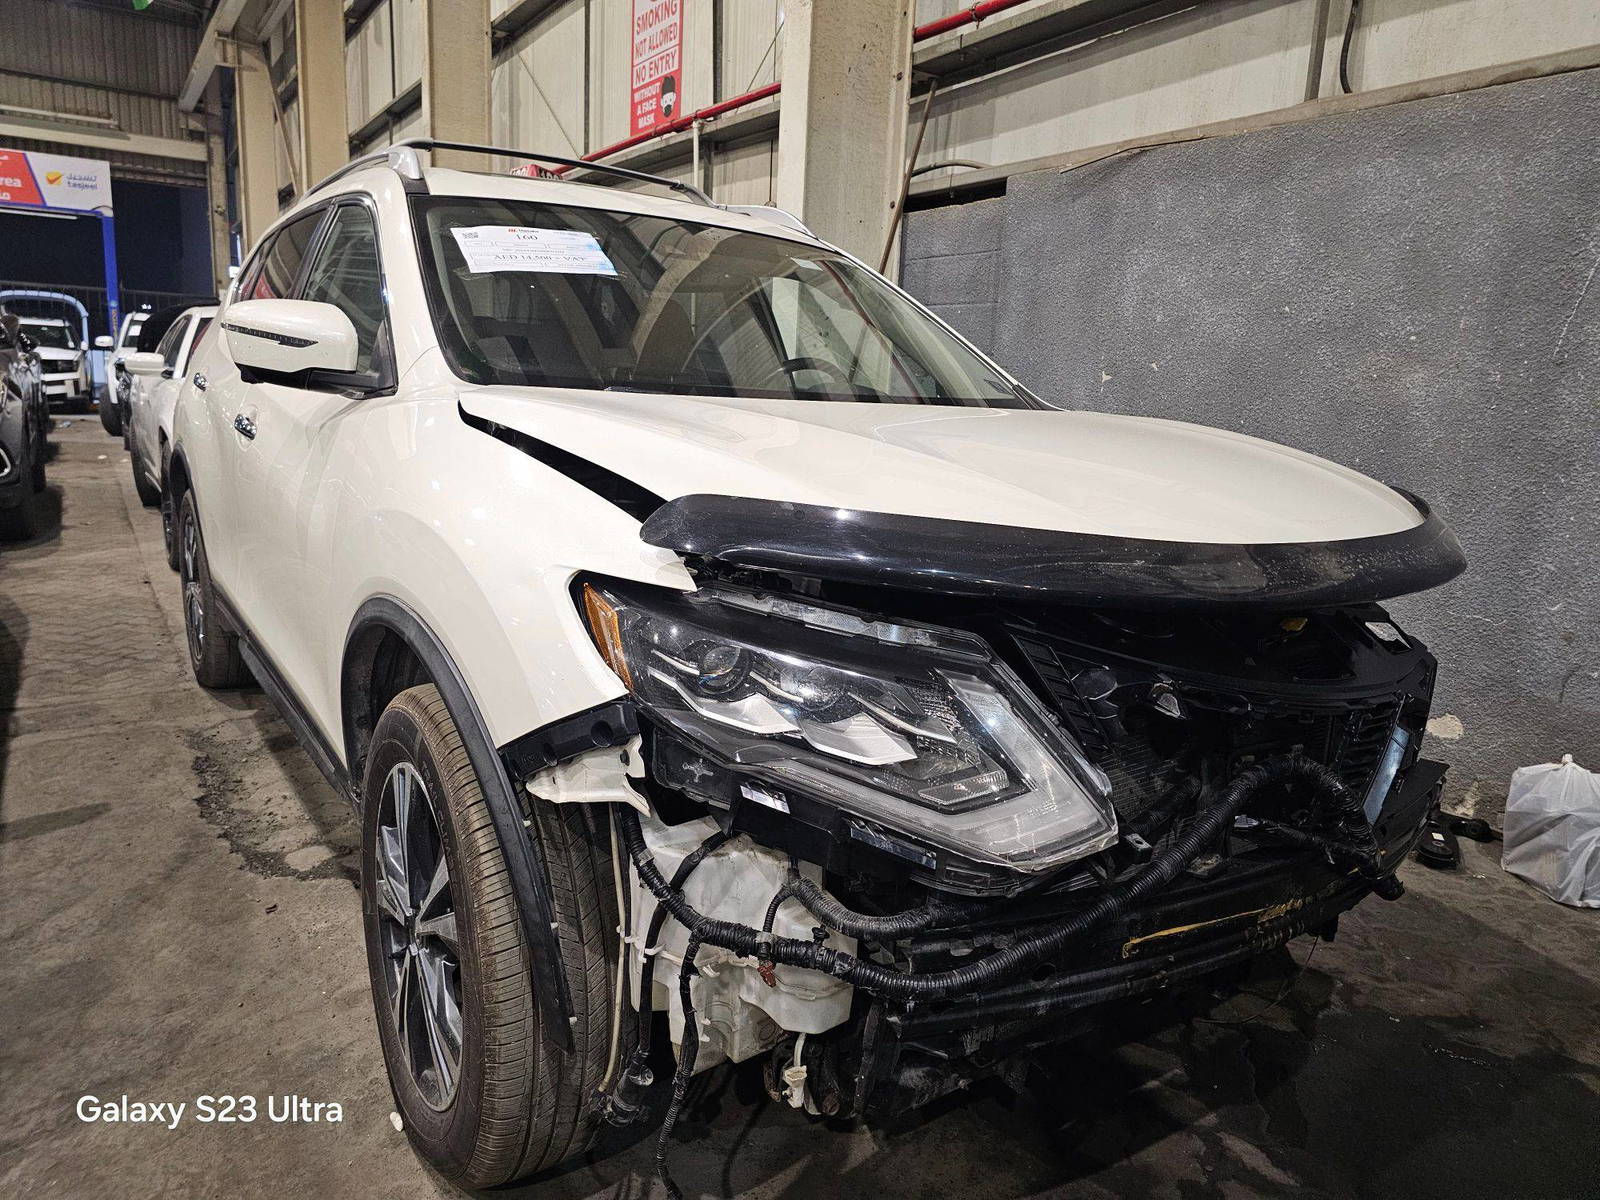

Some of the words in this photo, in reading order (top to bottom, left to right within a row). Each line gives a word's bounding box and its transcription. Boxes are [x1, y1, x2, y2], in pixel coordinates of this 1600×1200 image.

[636, 0, 678, 35] SMOKING
[635, 39, 647, 59] NOT
[648, 22, 678, 51] ALLOWED
[635, 65, 647, 84] NO
[649, 49, 677, 78] ENTRY
[634, 82, 661, 103] WITHOUT
